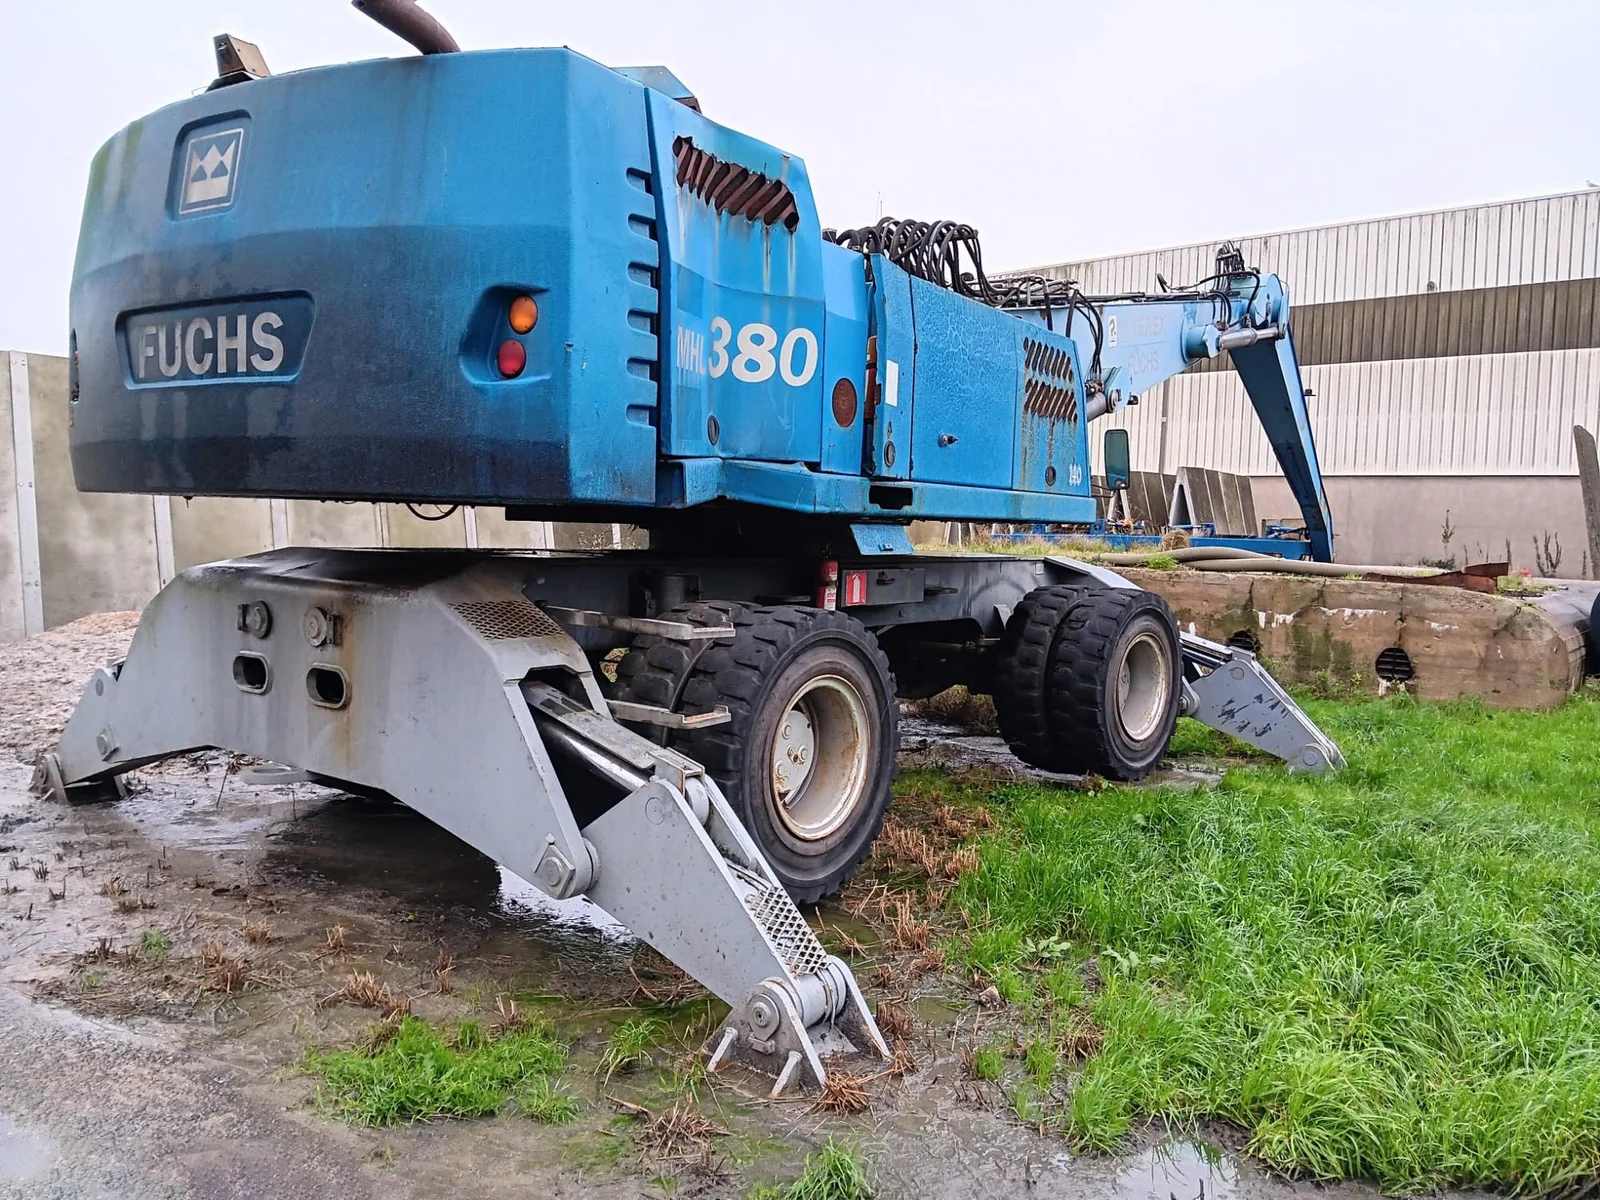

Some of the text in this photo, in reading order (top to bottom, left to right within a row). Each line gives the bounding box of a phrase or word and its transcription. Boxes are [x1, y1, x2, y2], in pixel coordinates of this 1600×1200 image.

[138, 311, 284, 379] FUCHS
[708, 316, 818, 386] 380
[1128, 350, 1159, 375] FUCHS
